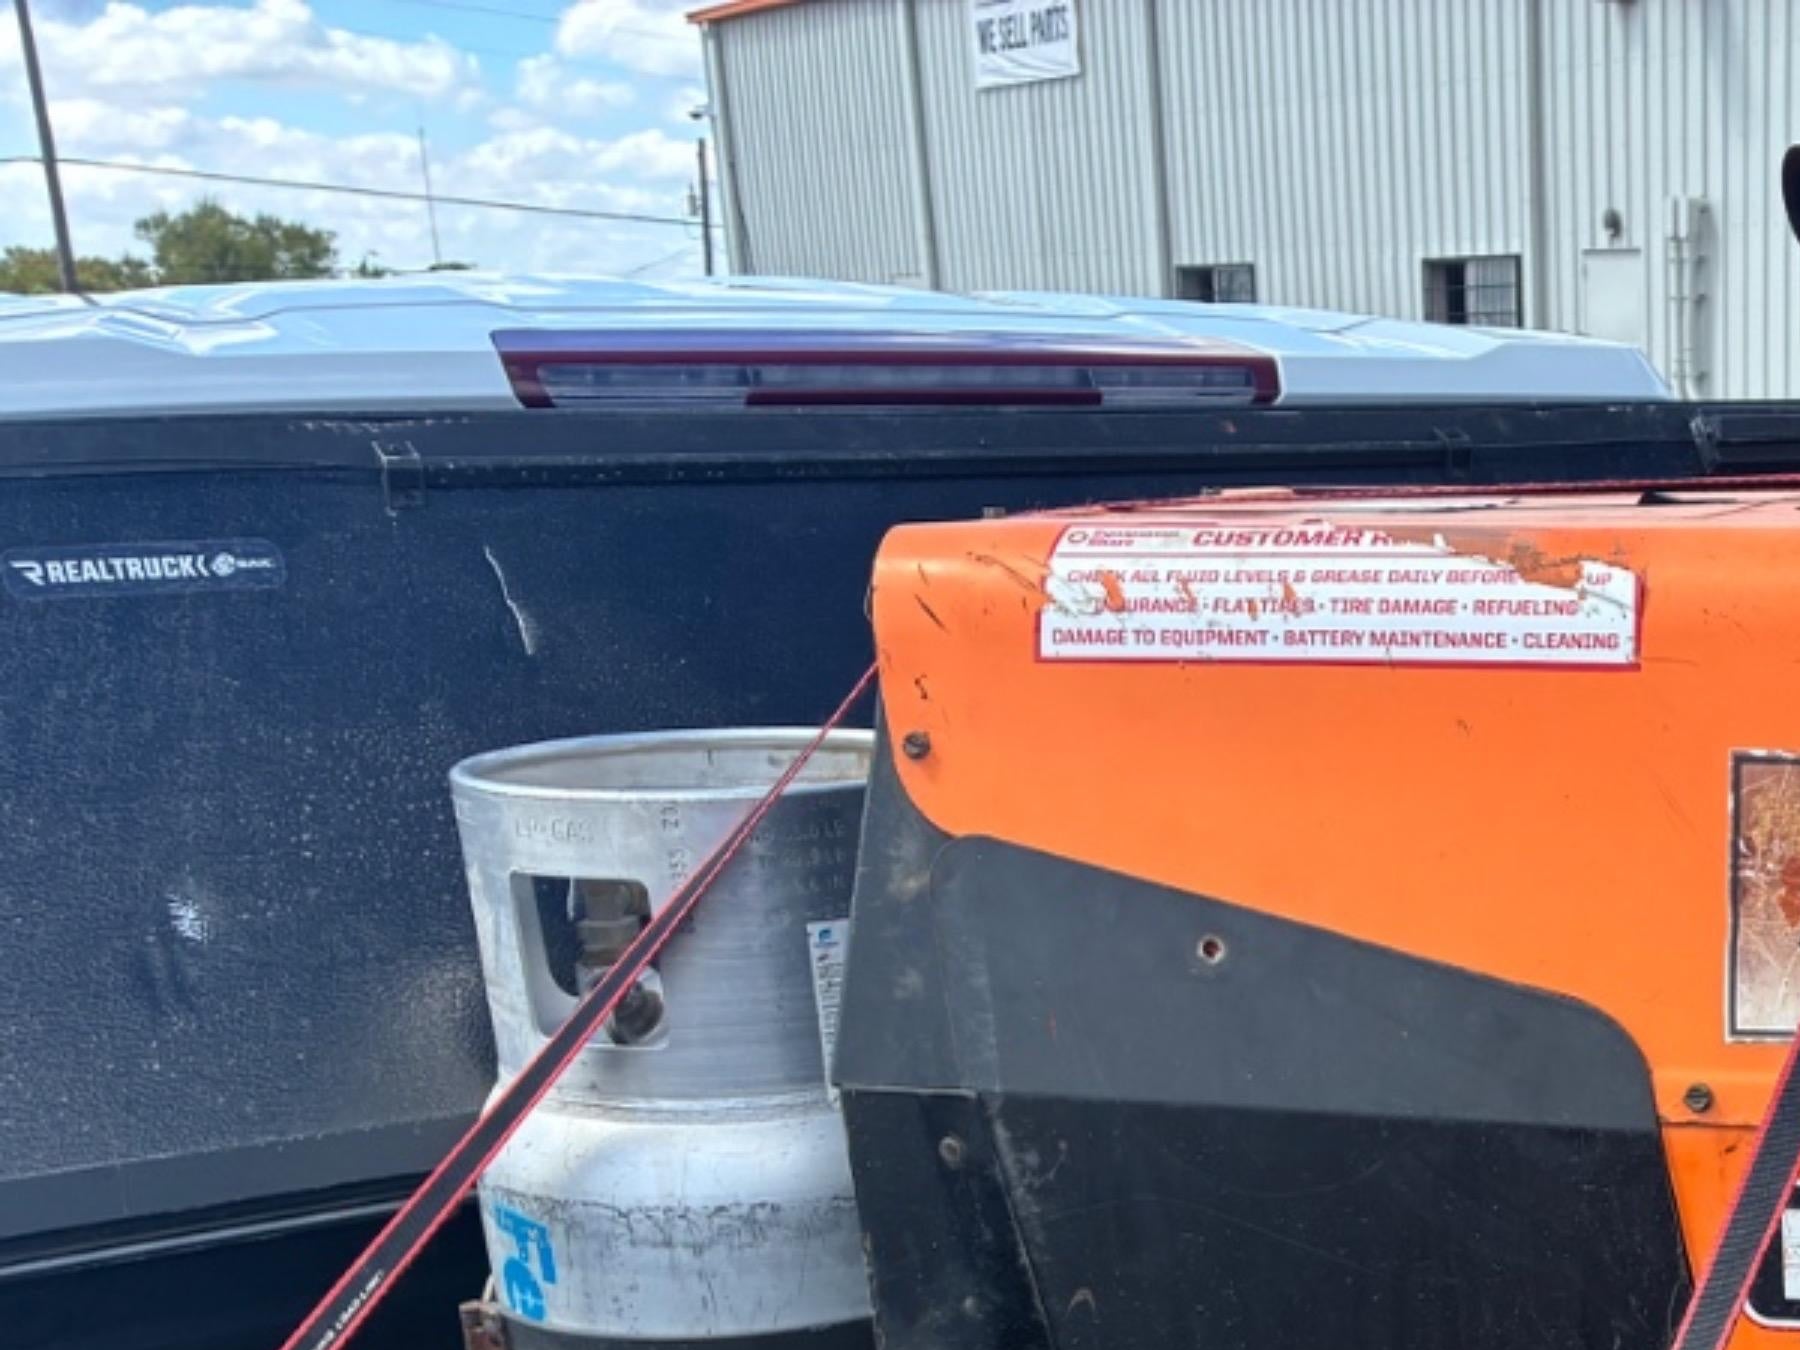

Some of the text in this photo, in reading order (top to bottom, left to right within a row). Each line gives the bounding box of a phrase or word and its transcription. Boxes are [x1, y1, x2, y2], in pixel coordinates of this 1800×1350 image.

[977, 5, 1069, 54] WE SELL PARTS
[1192, 528, 1363, 547] CUSTOMER
[45, 554, 198, 584] REALTRUCK
[1130, 569, 1160, 582] ALL
[1166, 569, 1219, 582] FLUID
[1223, 569, 1289, 582] LEVELS
[1311, 569, 1383, 583] GREASE
[1387, 569, 1443, 584] DAILY
[1446, 569, 1519, 584] BEFORE
[1094, 597, 1198, 613] IURANCE
[1329, 597, 1375, 615] TIRE
[1378, 598, 1458, 615] DAMAGE
[1472, 599, 1579, 615] REFUELING
[1052, 628, 1620, 649] DAMAGE TO EQUIPMENT BATTERY MAINTENANCE CLEANING
